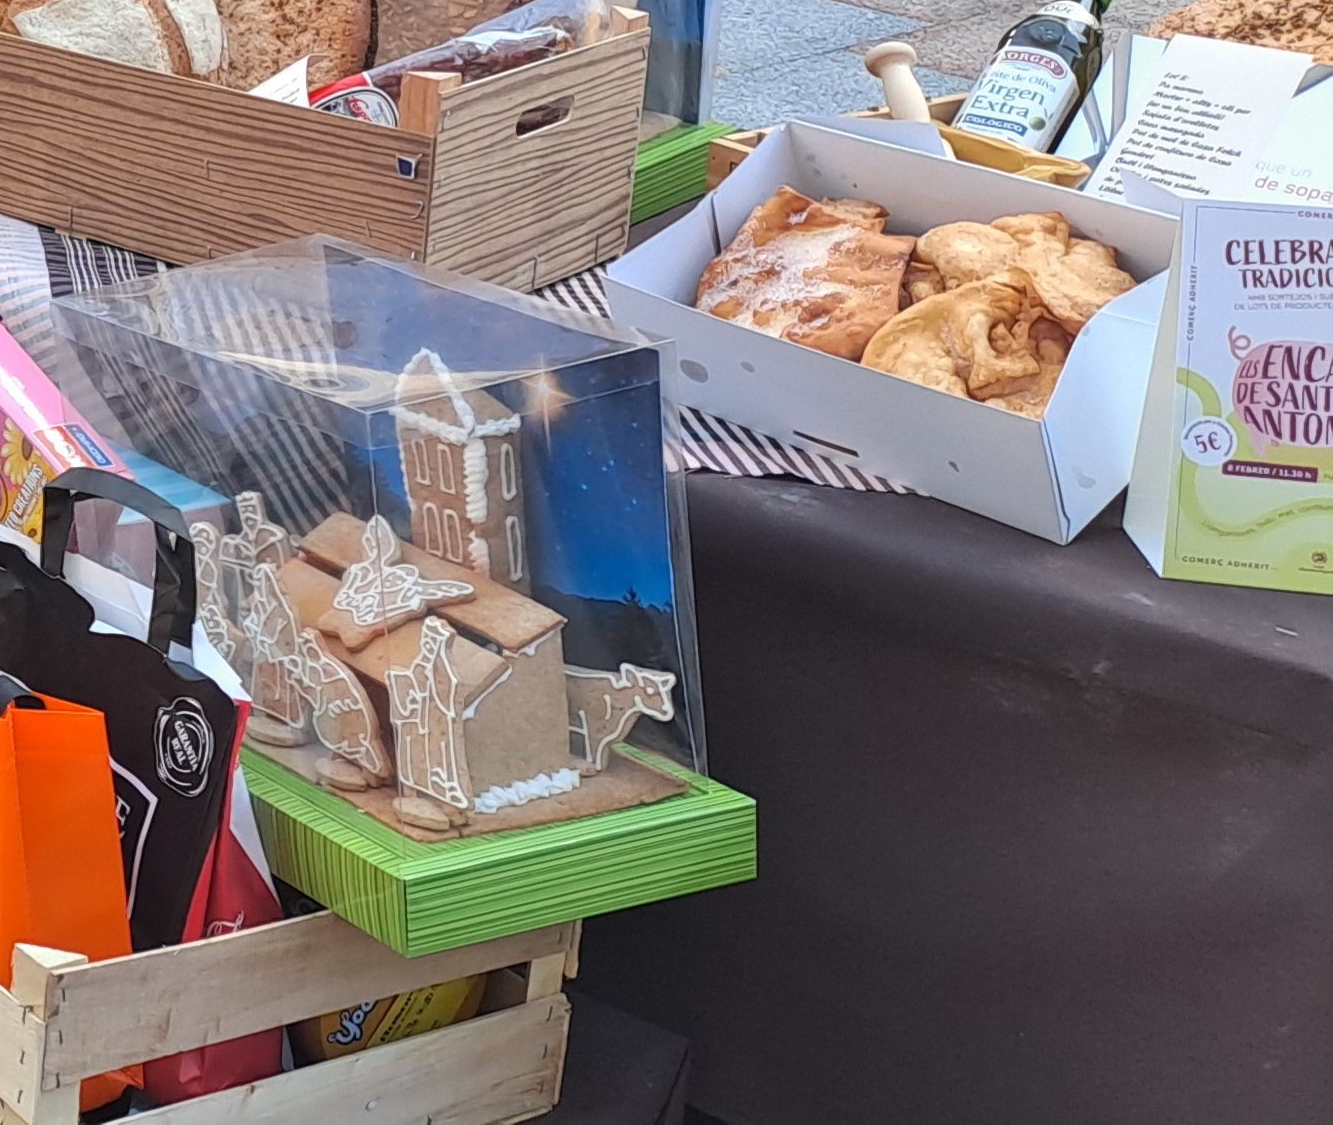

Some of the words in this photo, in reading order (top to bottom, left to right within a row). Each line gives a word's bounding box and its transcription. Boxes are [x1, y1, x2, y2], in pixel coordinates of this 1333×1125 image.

[981, 78, 1045, 106] Virgen
[1011, 73, 1026, 83] de
[1028, 77, 1057, 93] Oliva
[971, 95, 1030, 119] Extra
[1254, 175, 1279, 191] de
[1239, 359, 1260, 378] ELS
[1237, 382, 1261, 405] DE
[1194, 431, 1222, 454] 5€
[1181, 555, 1224, 566] COMERÇ
[1227, 560, 1270, 570] ADHERIT
[171, 736, 187, 766] REAL
[174, 720, 199, 772] GARANTIA
